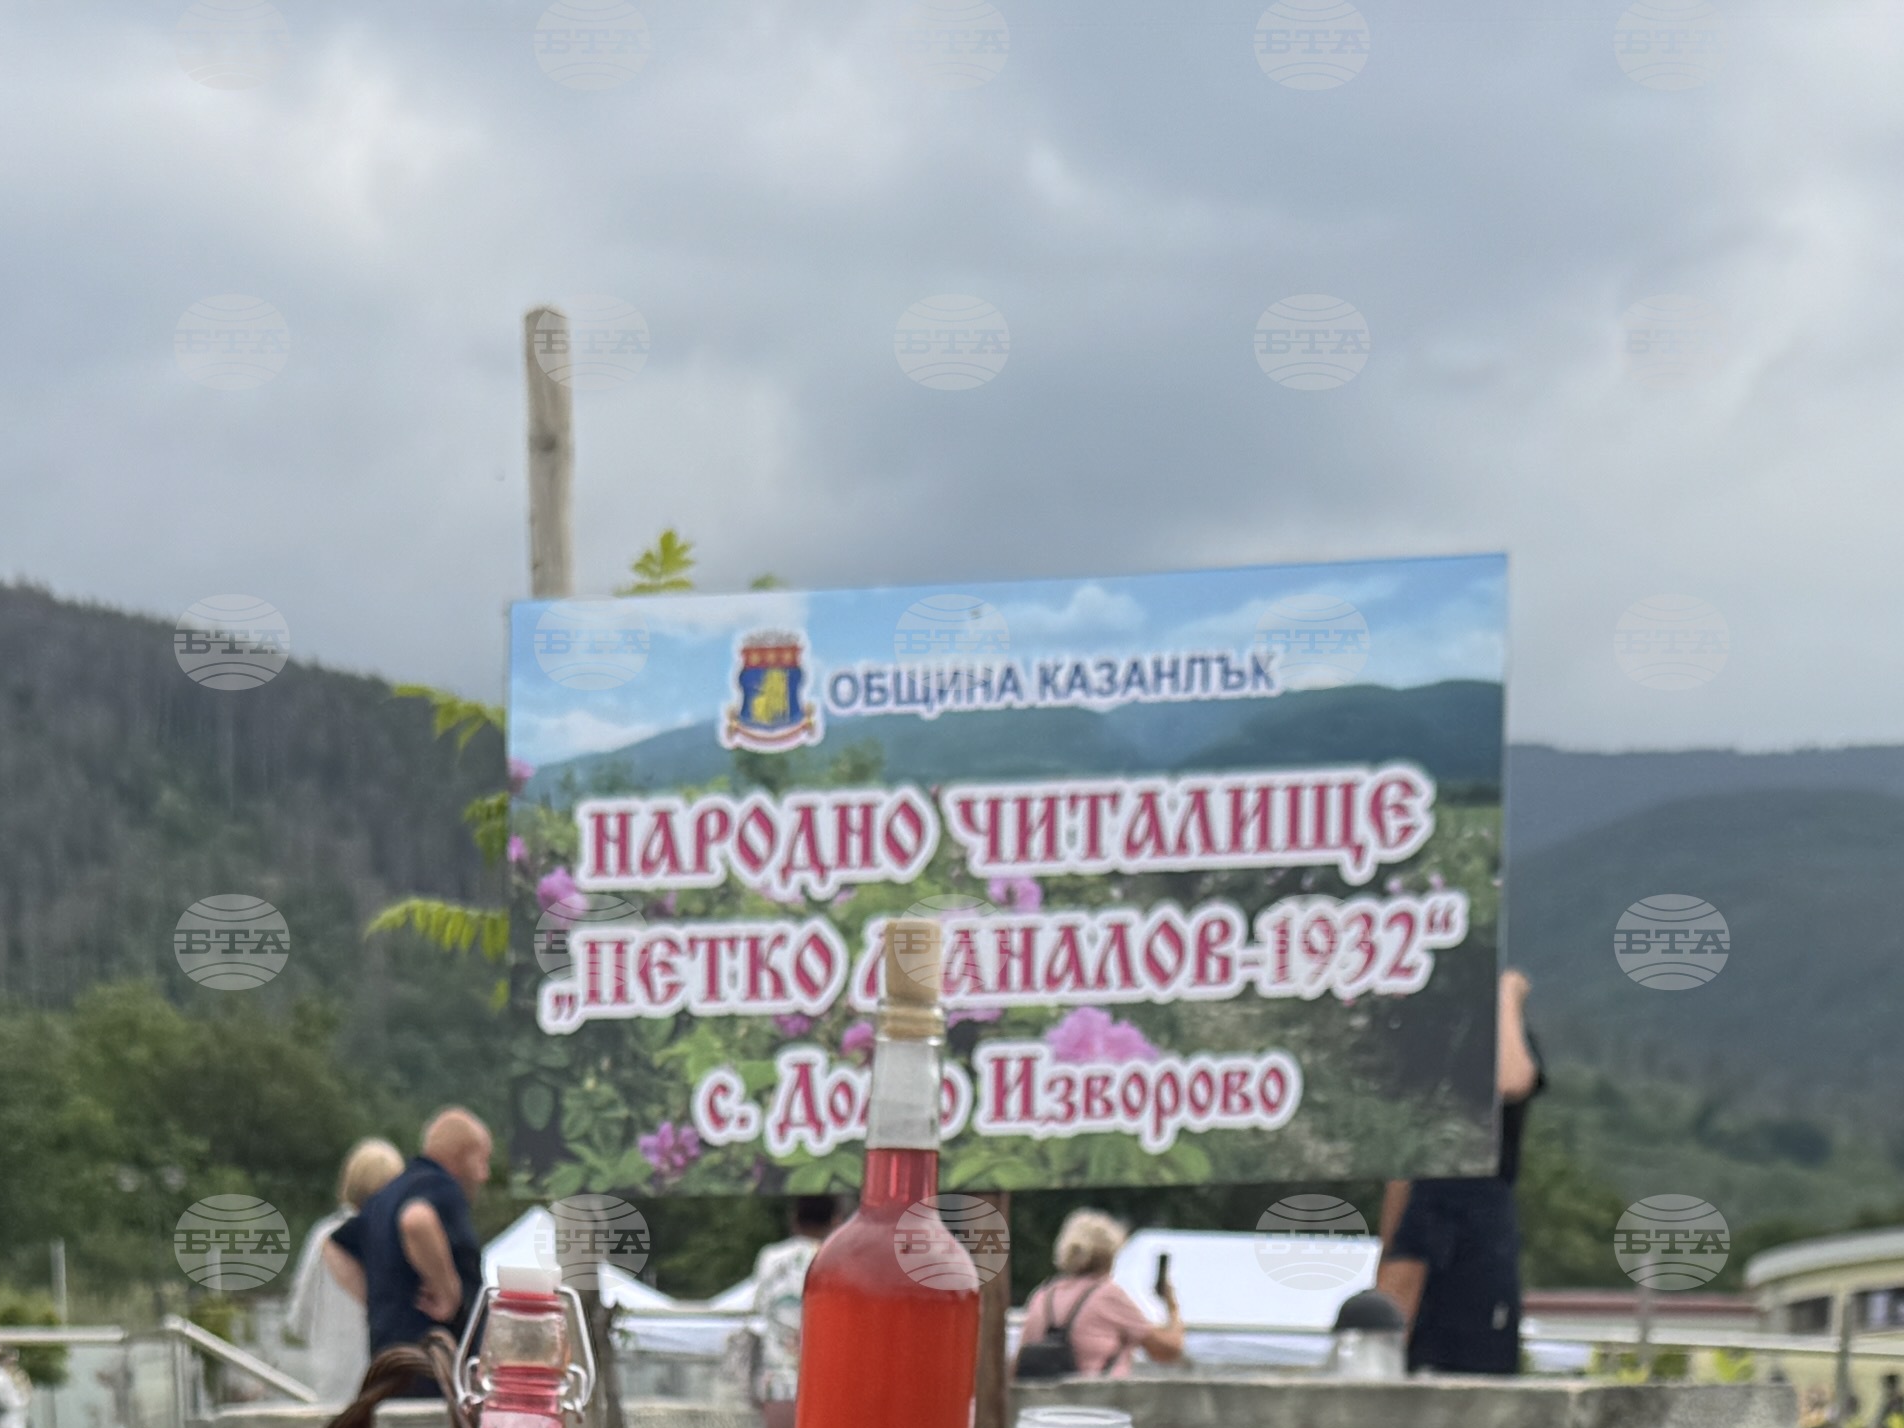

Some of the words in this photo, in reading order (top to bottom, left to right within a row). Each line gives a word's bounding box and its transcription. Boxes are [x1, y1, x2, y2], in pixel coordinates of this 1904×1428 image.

[829, 664, 1024, 711] ОБЩИНА
[1038, 653, 1278, 699] КАЗАНЛЪК
[590, 799, 924, 882] НАРОДНО
[957, 779, 1418, 866] ЧИТАЛИЩЕ
[553, 931, 834, 1012] „ПЕТКО
[863, 903, 1458, 998] АНАЛОВ-1932“
[706, 1082, 751, 1132] с.
[987, 1056, 1288, 1138] Изворово
